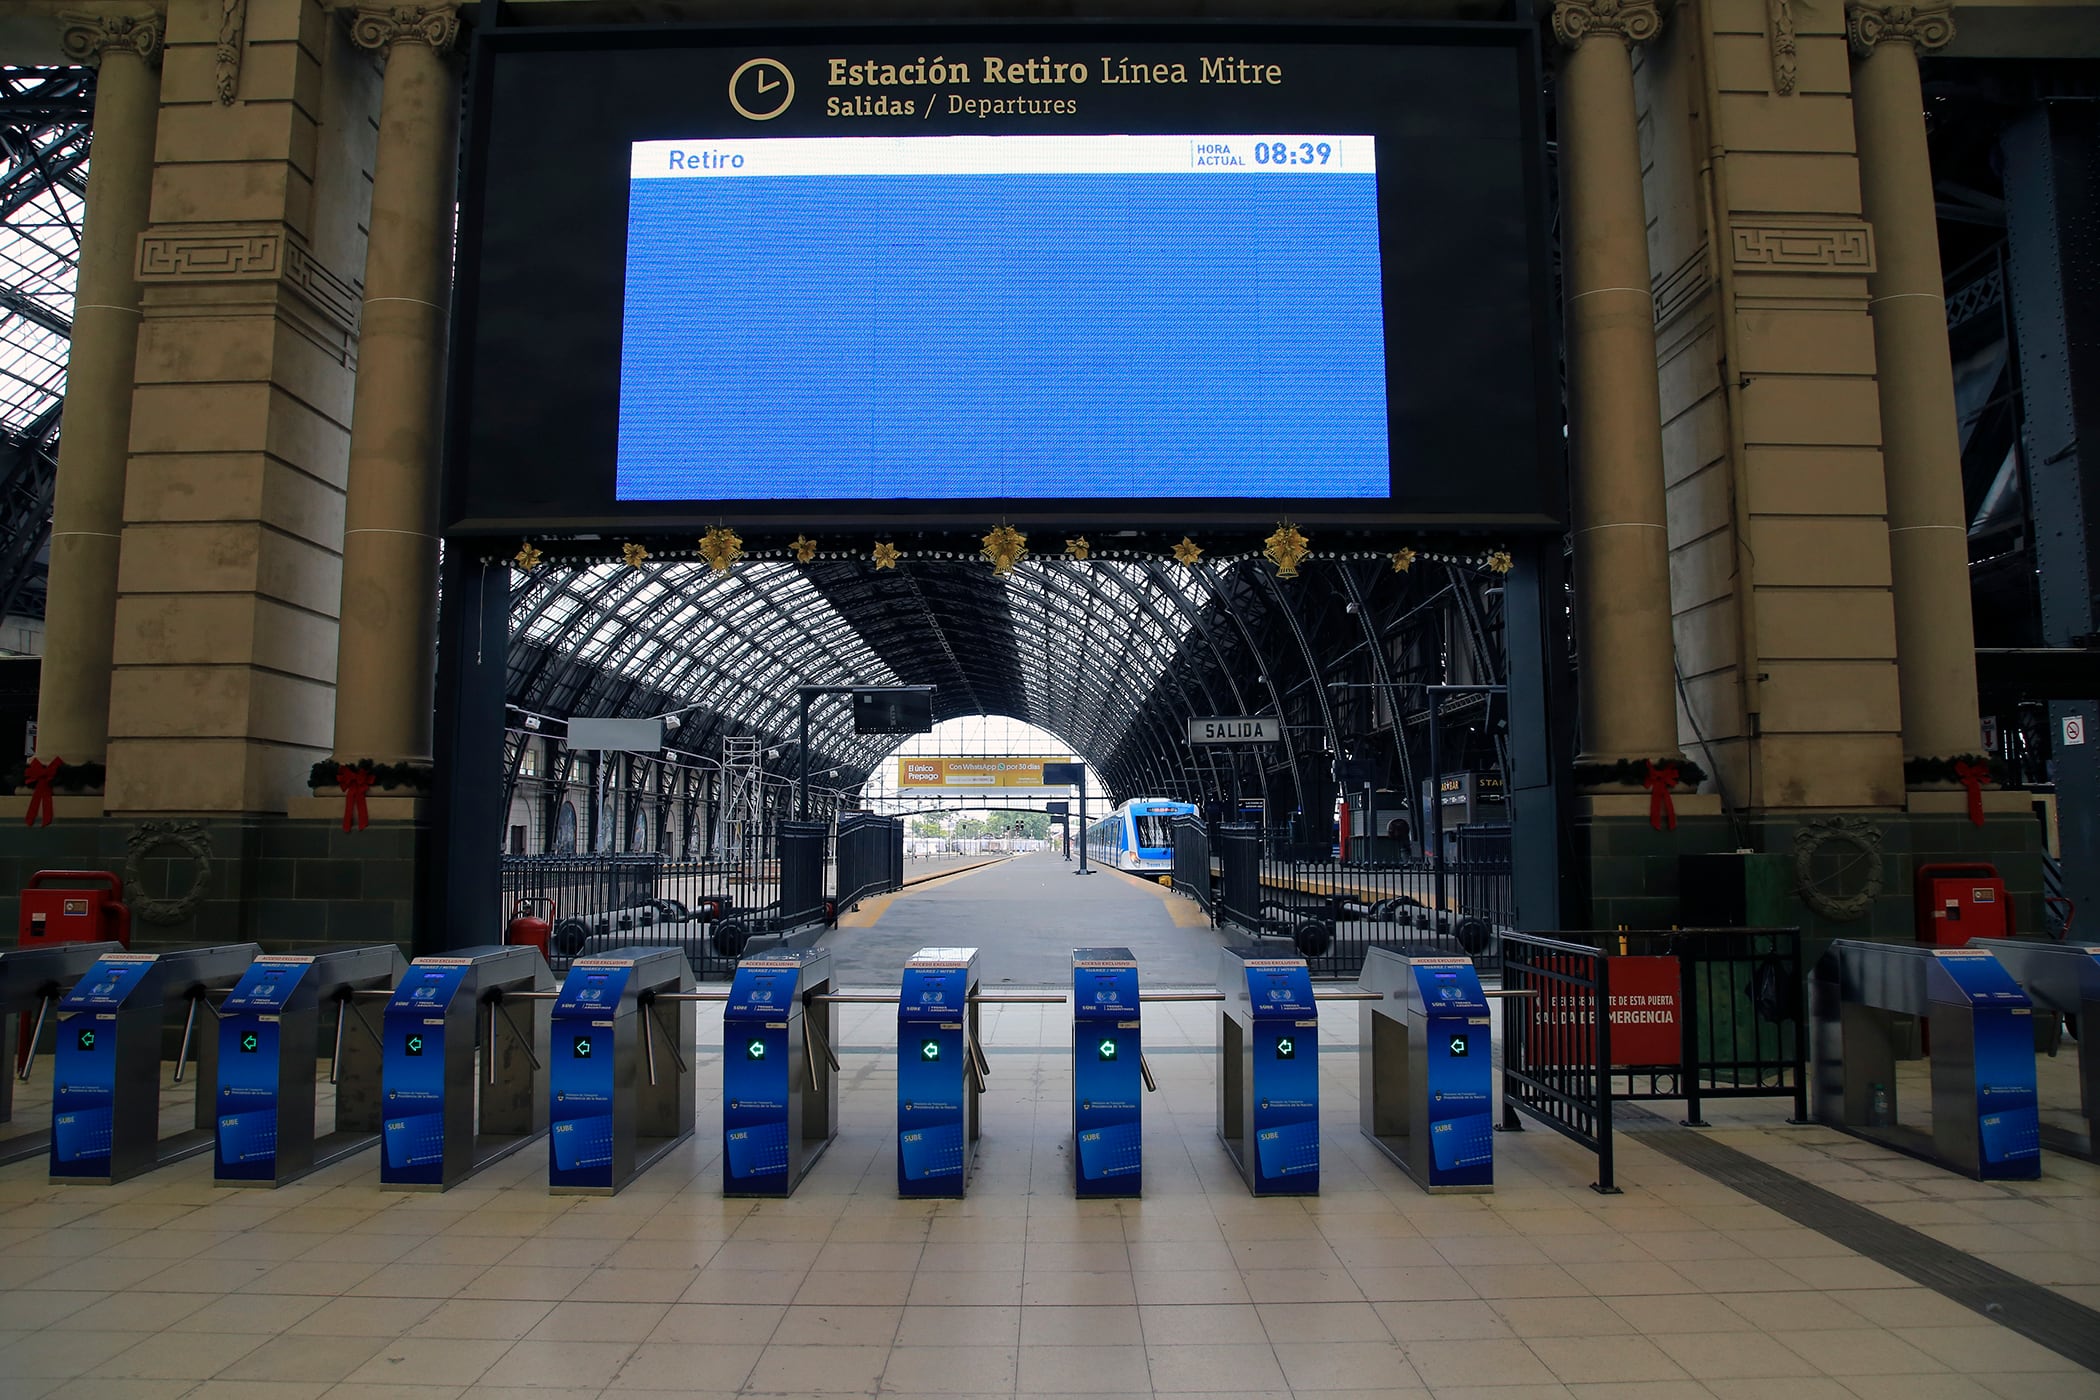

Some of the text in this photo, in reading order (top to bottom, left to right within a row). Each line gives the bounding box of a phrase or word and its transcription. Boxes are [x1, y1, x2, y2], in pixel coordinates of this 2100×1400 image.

[827, 55, 1282, 86] Estación Retiro Línea Mitre
[826, 93, 1076, 119] Salidas / Departures
[1197, 144, 1231, 154] HORA
[1254, 142, 1332, 165] 08:39
[669, 149, 745, 170] Retiro
[1197, 156, 1246, 166] ACTUAL
[1206, 722, 1264, 738] SALIDA
[963, 763, 996, 772] WhatsApp
[1618, 996, 1627, 1006] DE
[1630, 996, 1646, 1006] ESTA
[1648, 996, 1673, 1006] PUERTA
[1609, 1011, 1674, 1023] MERGENCIA
[387, 1122, 405, 1130] SUBE
[555, 1124, 573, 1133] SUBE
[1434, 1124, 1452, 1133] SUBE
[730, 1132, 748, 1141] SUBE
[904, 1133, 922, 1142] SUBE
[1082, 1133, 1101, 1142] SUBE
[1260, 1132, 1279, 1141] SUBE
